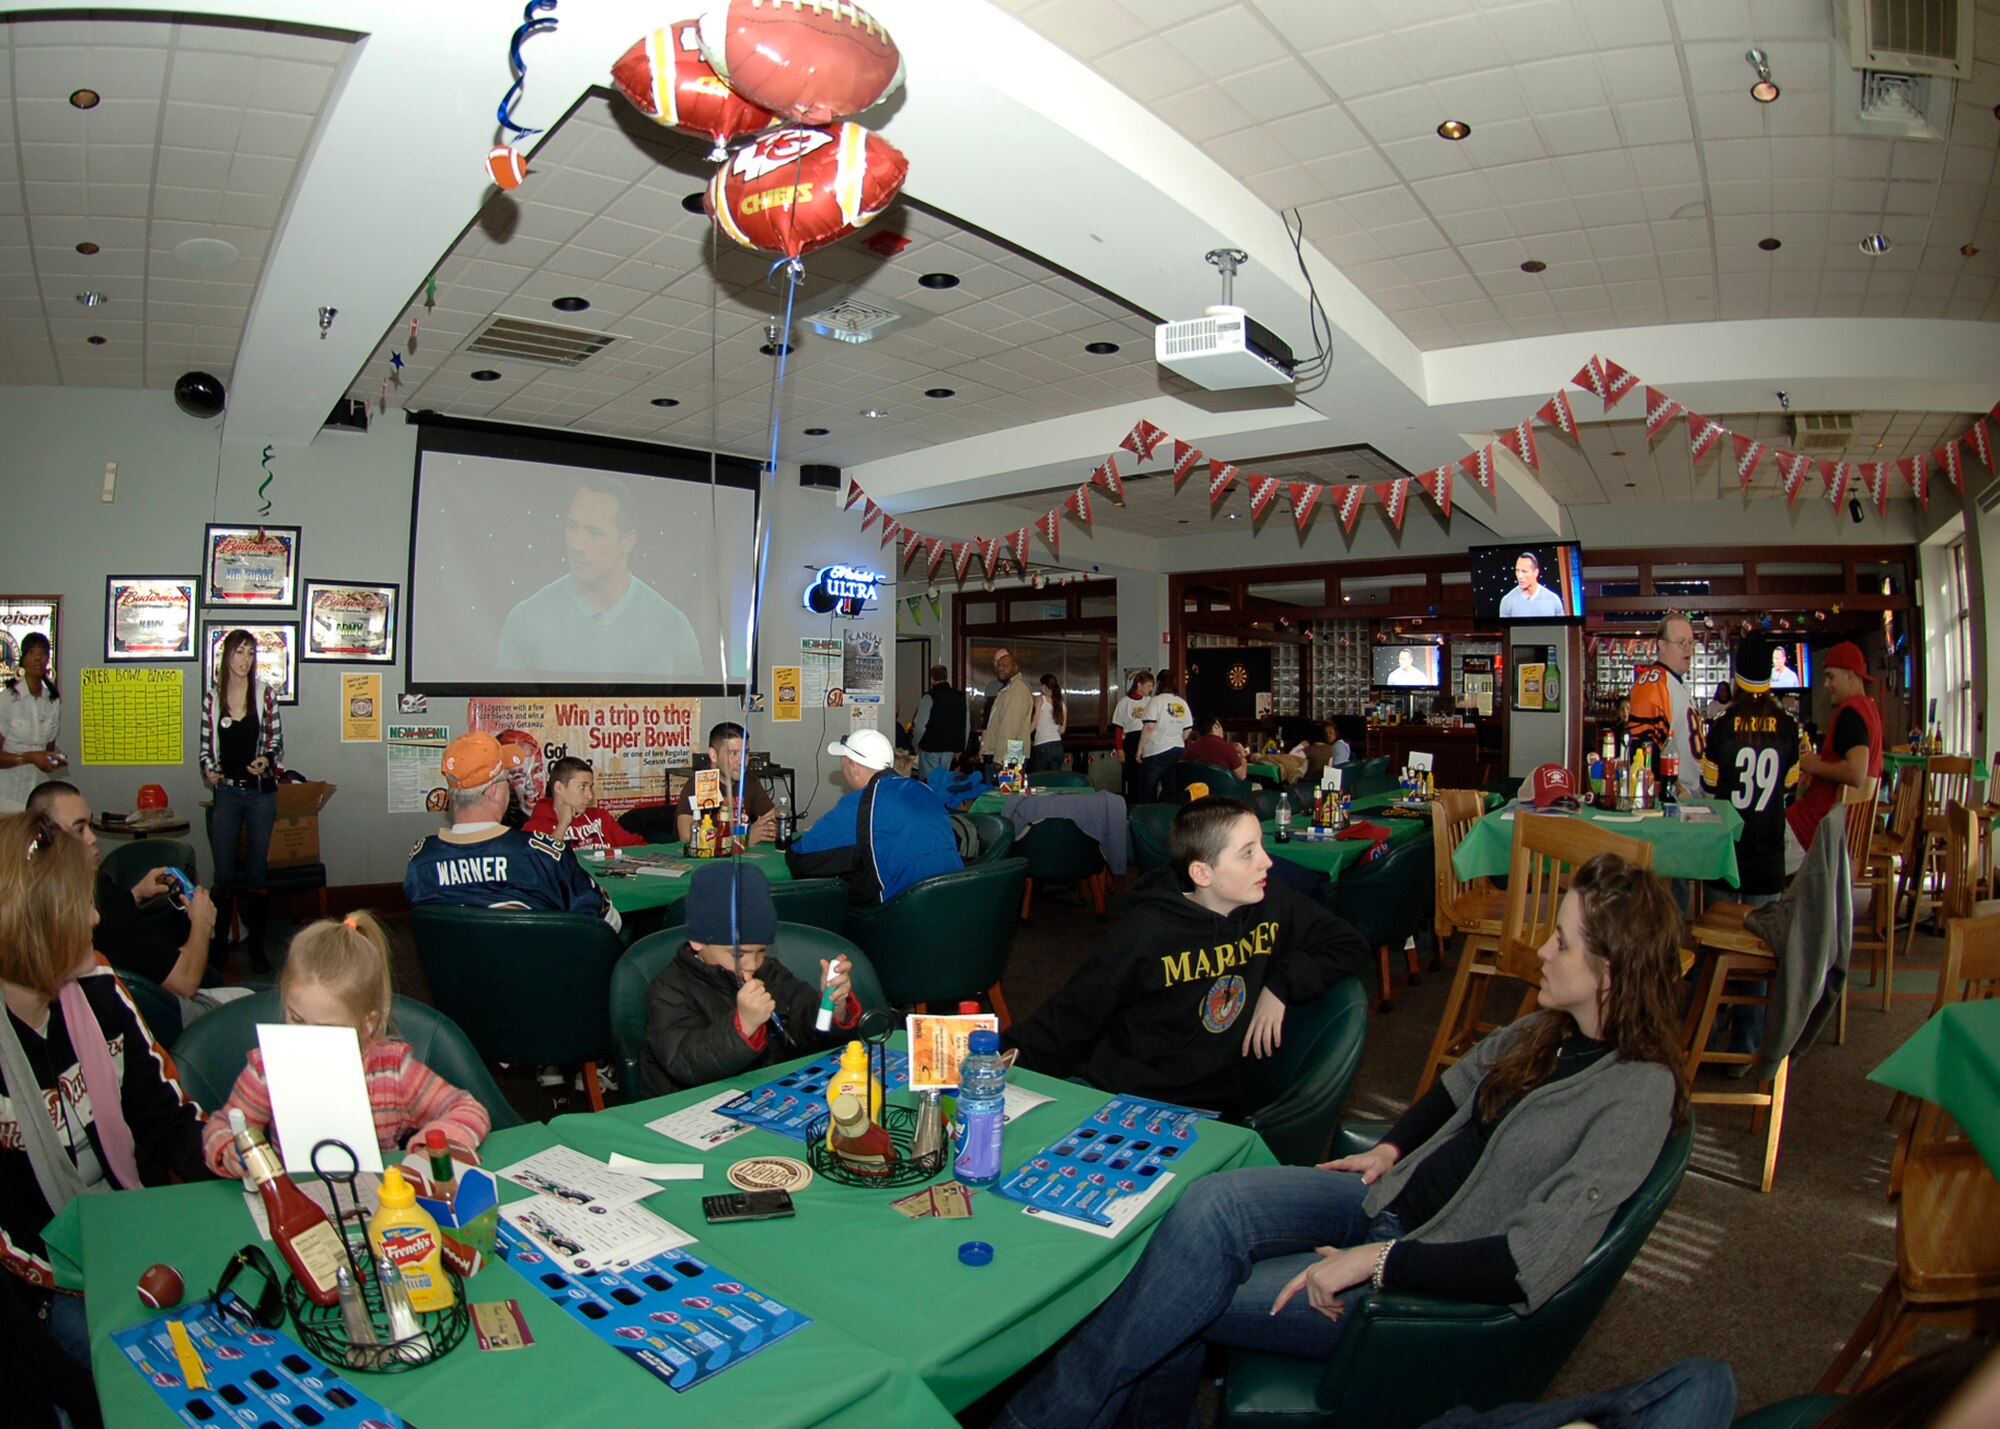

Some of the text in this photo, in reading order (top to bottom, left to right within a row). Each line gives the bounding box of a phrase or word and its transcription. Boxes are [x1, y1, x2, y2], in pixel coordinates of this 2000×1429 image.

[741, 183, 813, 215] CHIEFS
[215, 539, 287, 554] Budweiser
[120, 590, 188, 606] Budweiser
[826, 579, 878, 600] ULTRA
[314, 594, 387, 610] Budweiser
[0, 610, 49, 626] eiser
[115, 669, 143, 682] BOWL
[147, 669, 177, 684] BINGO
[515, 712, 527, 720] and
[555, 703, 691, 731] Win a trip to the
[589, 725, 690, 754] Super Bowl!
[543, 742, 568, 760] Got
[652, 749, 663, 757] two
[665, 749, 689, 759] Regular
[643, 757, 689, 766] Season Games
[1731, 747, 1780, 812] 39
[436, 857, 508, 886] WARNER
[1161, 922, 1279, 987] MARNES
[385, 1238, 431, 1259] French's
